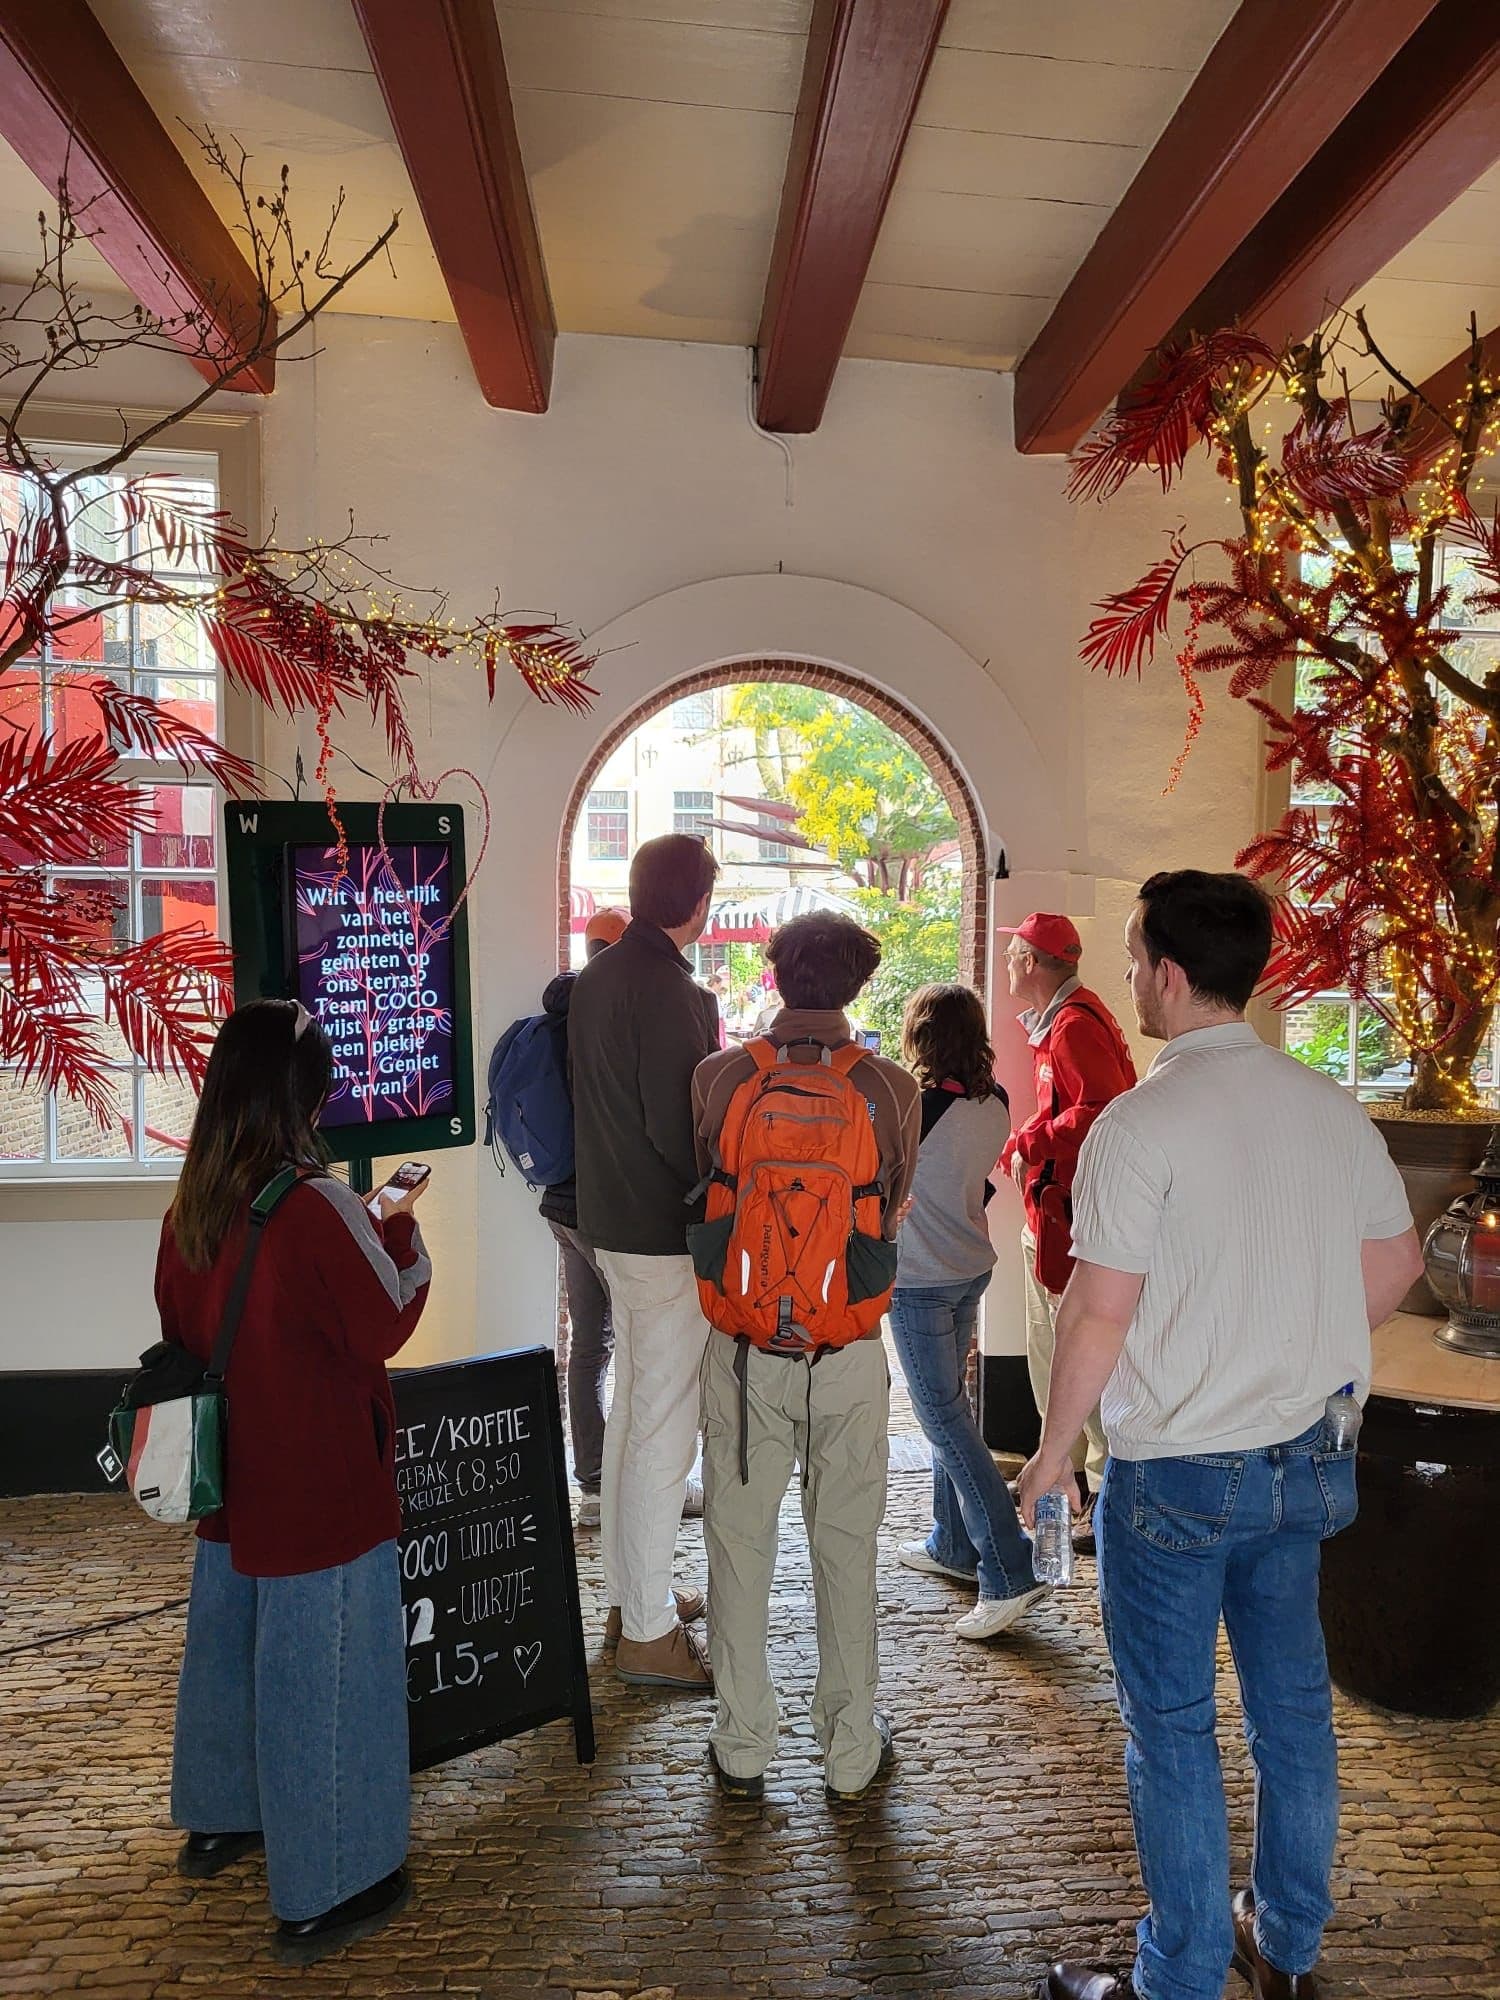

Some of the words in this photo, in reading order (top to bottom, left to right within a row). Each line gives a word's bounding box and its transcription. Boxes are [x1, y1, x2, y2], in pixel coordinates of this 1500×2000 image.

[239, 814, 258, 833] W
[438, 816, 451, 834] S
[355, 891, 365, 903] u
[374, 885, 440, 905] heerlijk
[341, 913, 372, 926] van
[381, 909, 410, 925] het
[337, 930, 414, 949] zonnetje
[321, 953, 399, 974] genieten
[407, 953, 430, 969] op
[327, 979, 358, 993] ons
[366, 972, 426, 990] terras?
[315, 998, 366, 1015] Team
[375, 990, 437, 1010] COCO
[324, 1019, 361, 1039] wijst
[370, 1020, 380, 1032] u
[388, 1015, 435, 1034] graag
[332, 1042, 364, 1057] een
[373, 1035, 424, 1057] plekje
[380, 1055, 439, 1074] Geniet
[352, 1076, 407, 1097] ervan!
[450, 1117, 462, 1135] S
[397, 1460, 448, 1491] GEBAK
[408, 1483, 455, 1512] KEUZE
[398, 1531, 448, 1580] OCO
[458, 1516, 517, 1561] LUNCH
